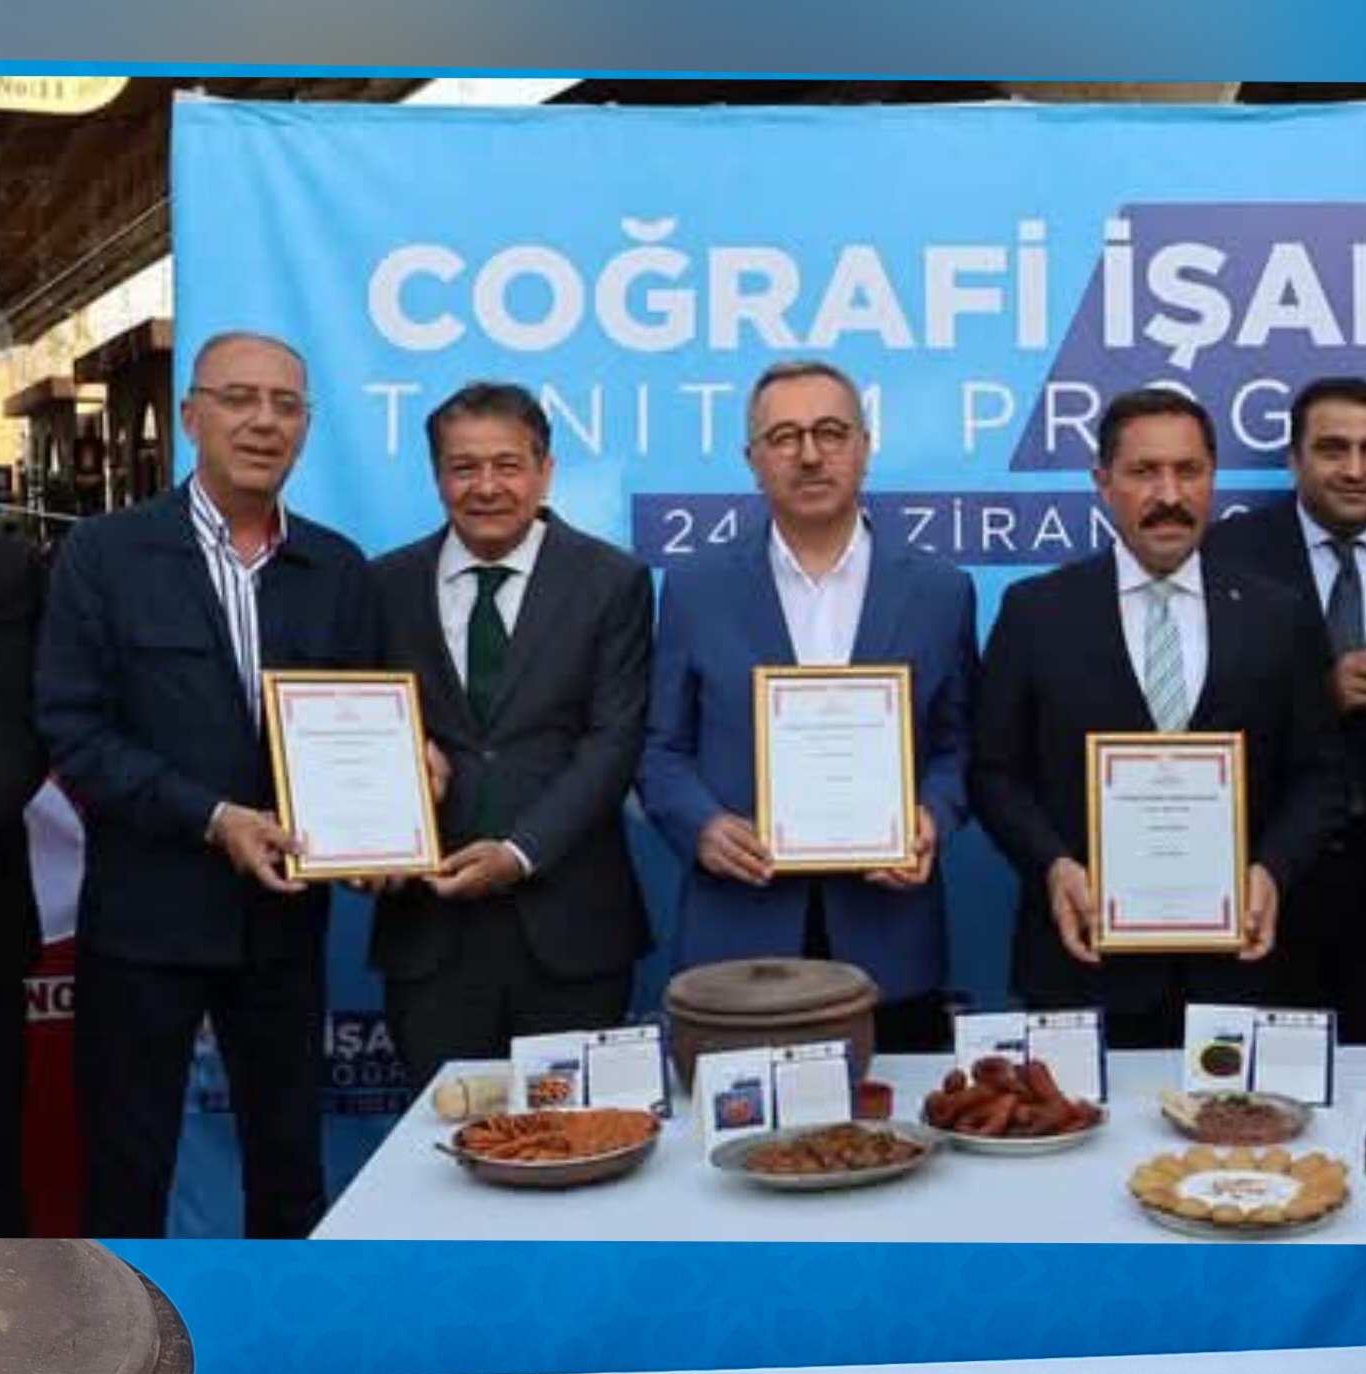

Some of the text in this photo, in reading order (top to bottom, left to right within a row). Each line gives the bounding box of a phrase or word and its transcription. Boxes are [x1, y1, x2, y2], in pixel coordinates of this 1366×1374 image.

[368, 217, 1048, 351] COĞRAFİ
[363, 382, 881, 456] TNIT
[902, 500, 1119, 551] ZİRAN
